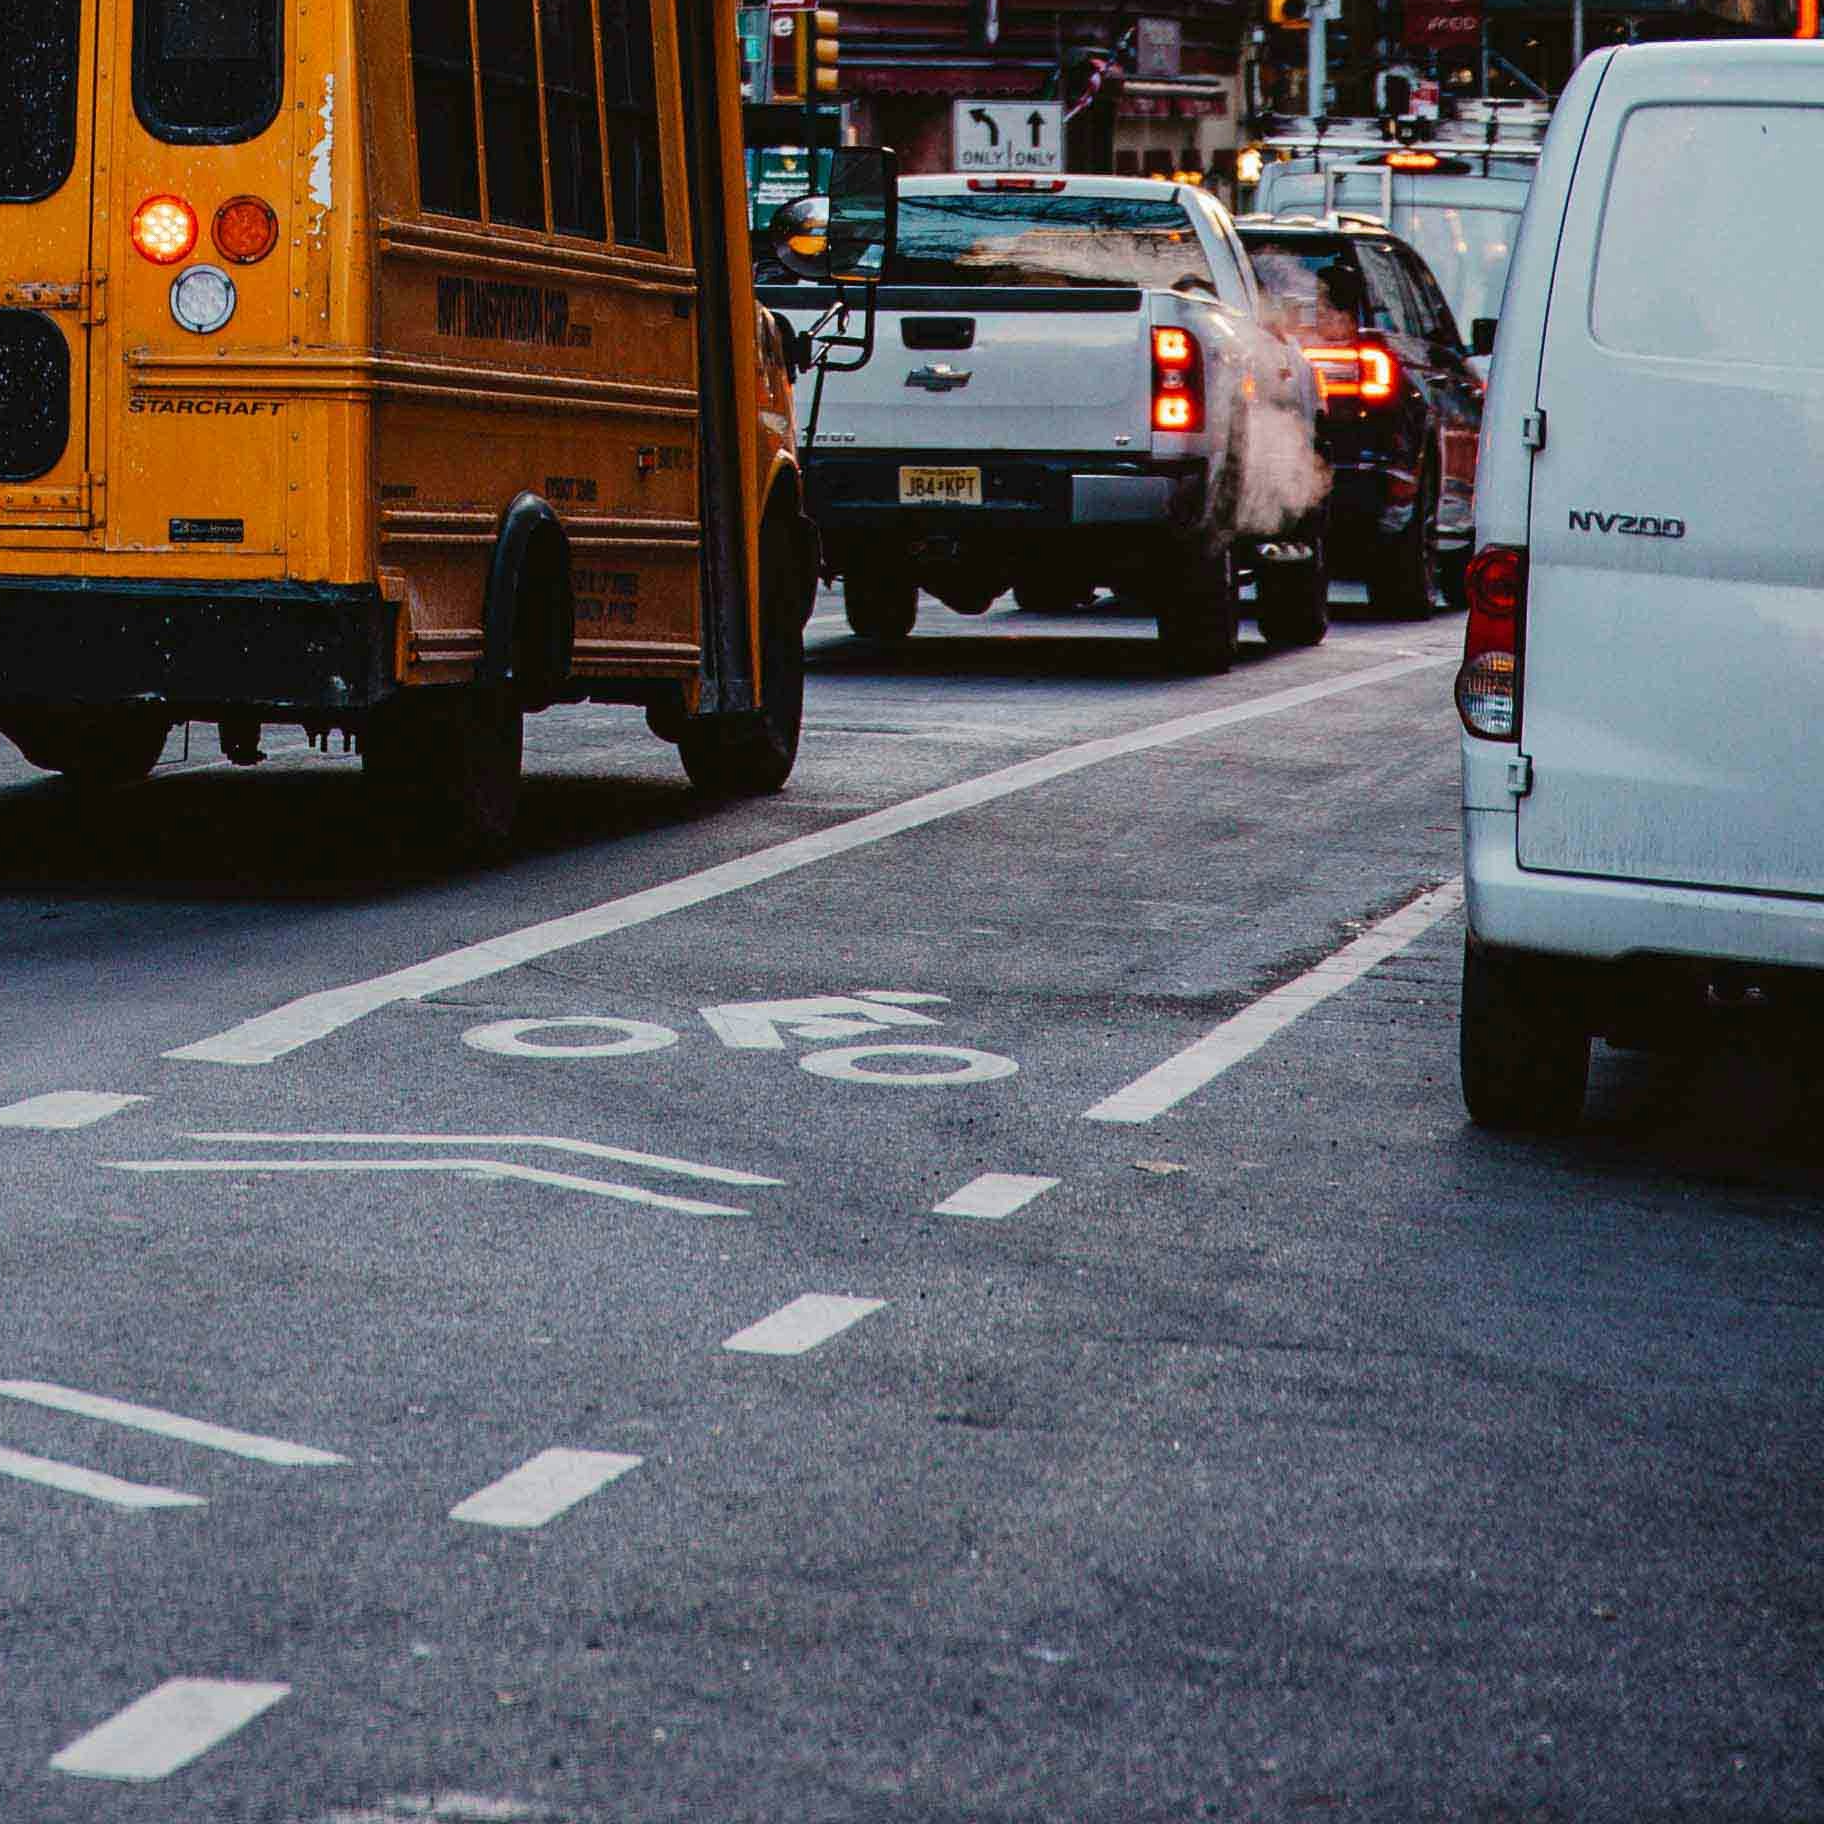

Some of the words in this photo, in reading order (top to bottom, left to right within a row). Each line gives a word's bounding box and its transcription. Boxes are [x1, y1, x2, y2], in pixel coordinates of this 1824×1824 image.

[962, 152, 1003, 166] ONLY
[1014, 153, 1056, 167] ONLY
[128, 399, 285, 416] STARCRAFT
[1568, 510, 1686, 539] NV200
